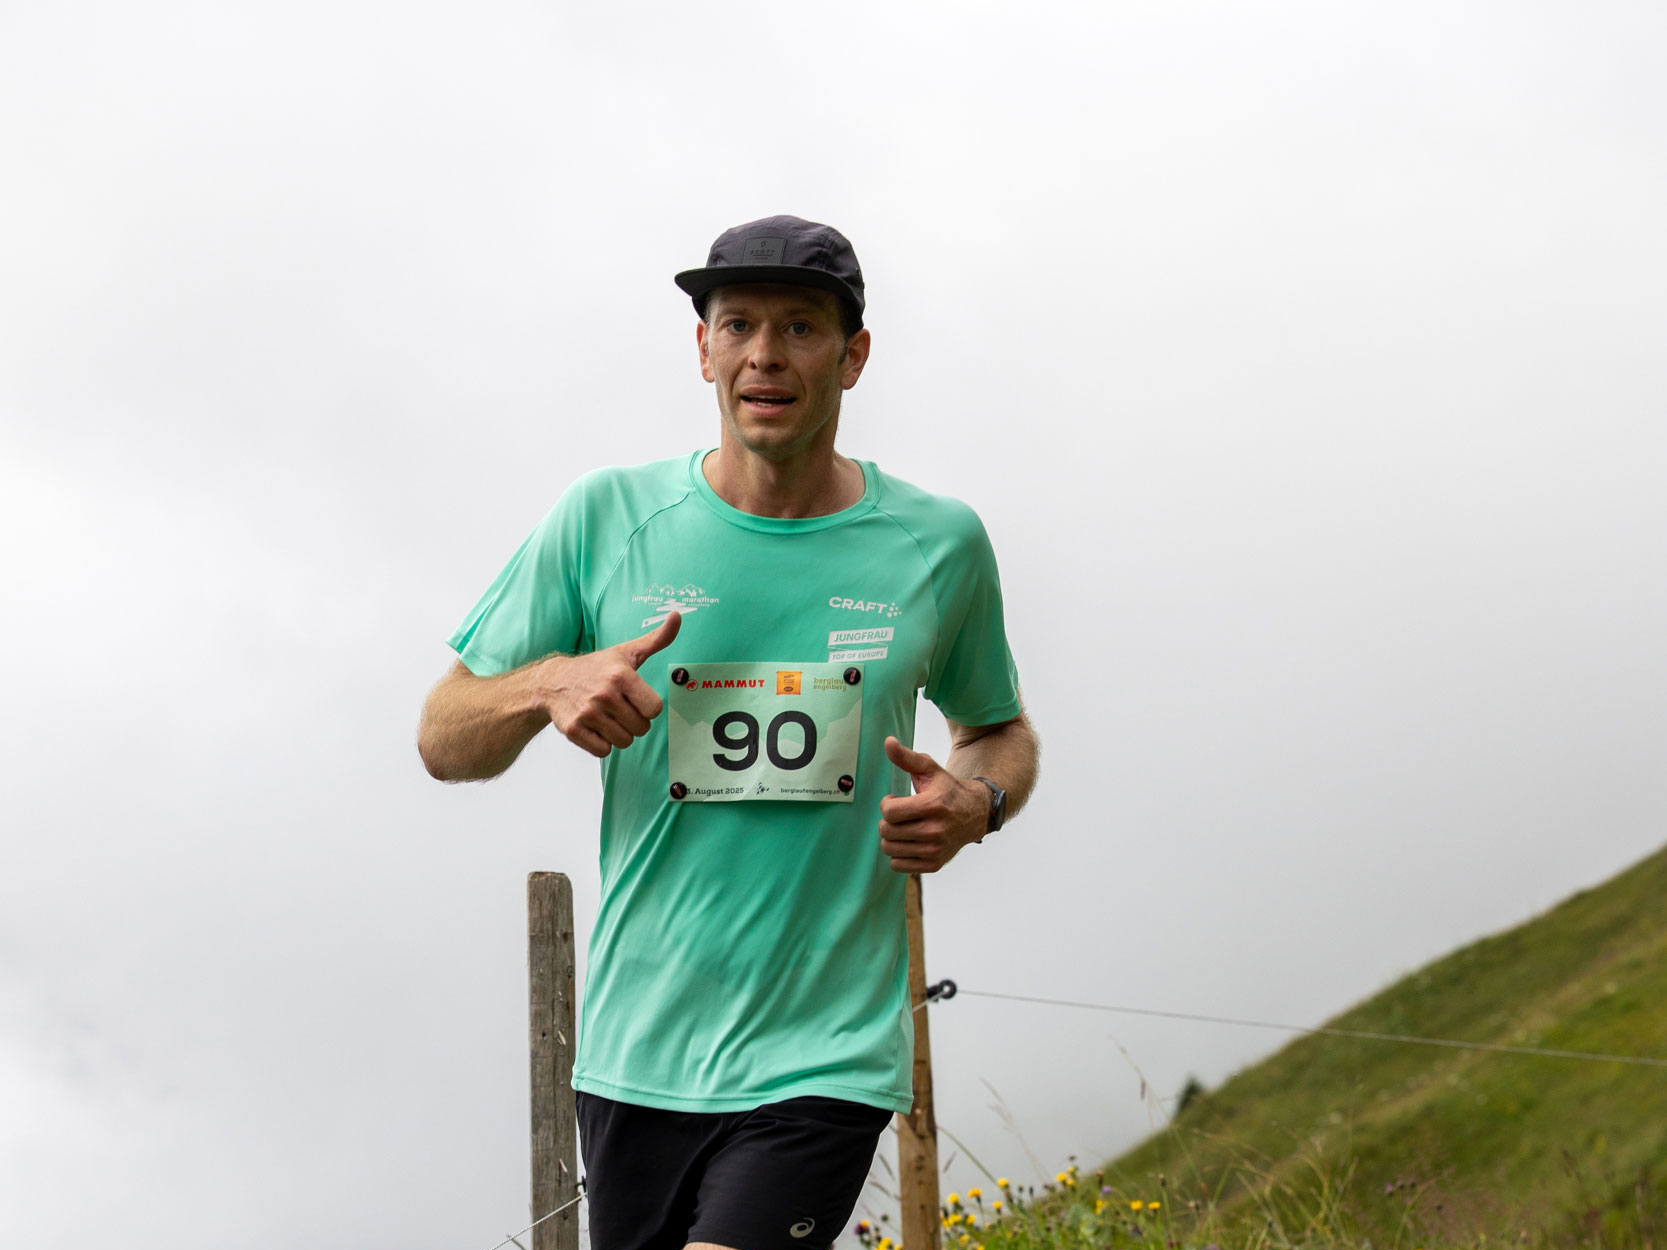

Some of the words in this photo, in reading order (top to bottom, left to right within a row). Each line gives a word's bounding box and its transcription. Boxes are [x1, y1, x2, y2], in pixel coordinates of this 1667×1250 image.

[631, 594, 663, 604] jungfrau
[682, 596, 720, 604] marathon
[828, 596, 888, 614] CRAFT
[834, 630, 888, 642] JUNGFRAU
[858, 650, 884, 658] EUROPE
[701, 679, 765, 689] MAMMUT
[813, 676, 847, 685] berglau
[712, 710, 818, 771] 90
[694, 788, 724, 797] August
[725, 787, 744, 795] 2025
